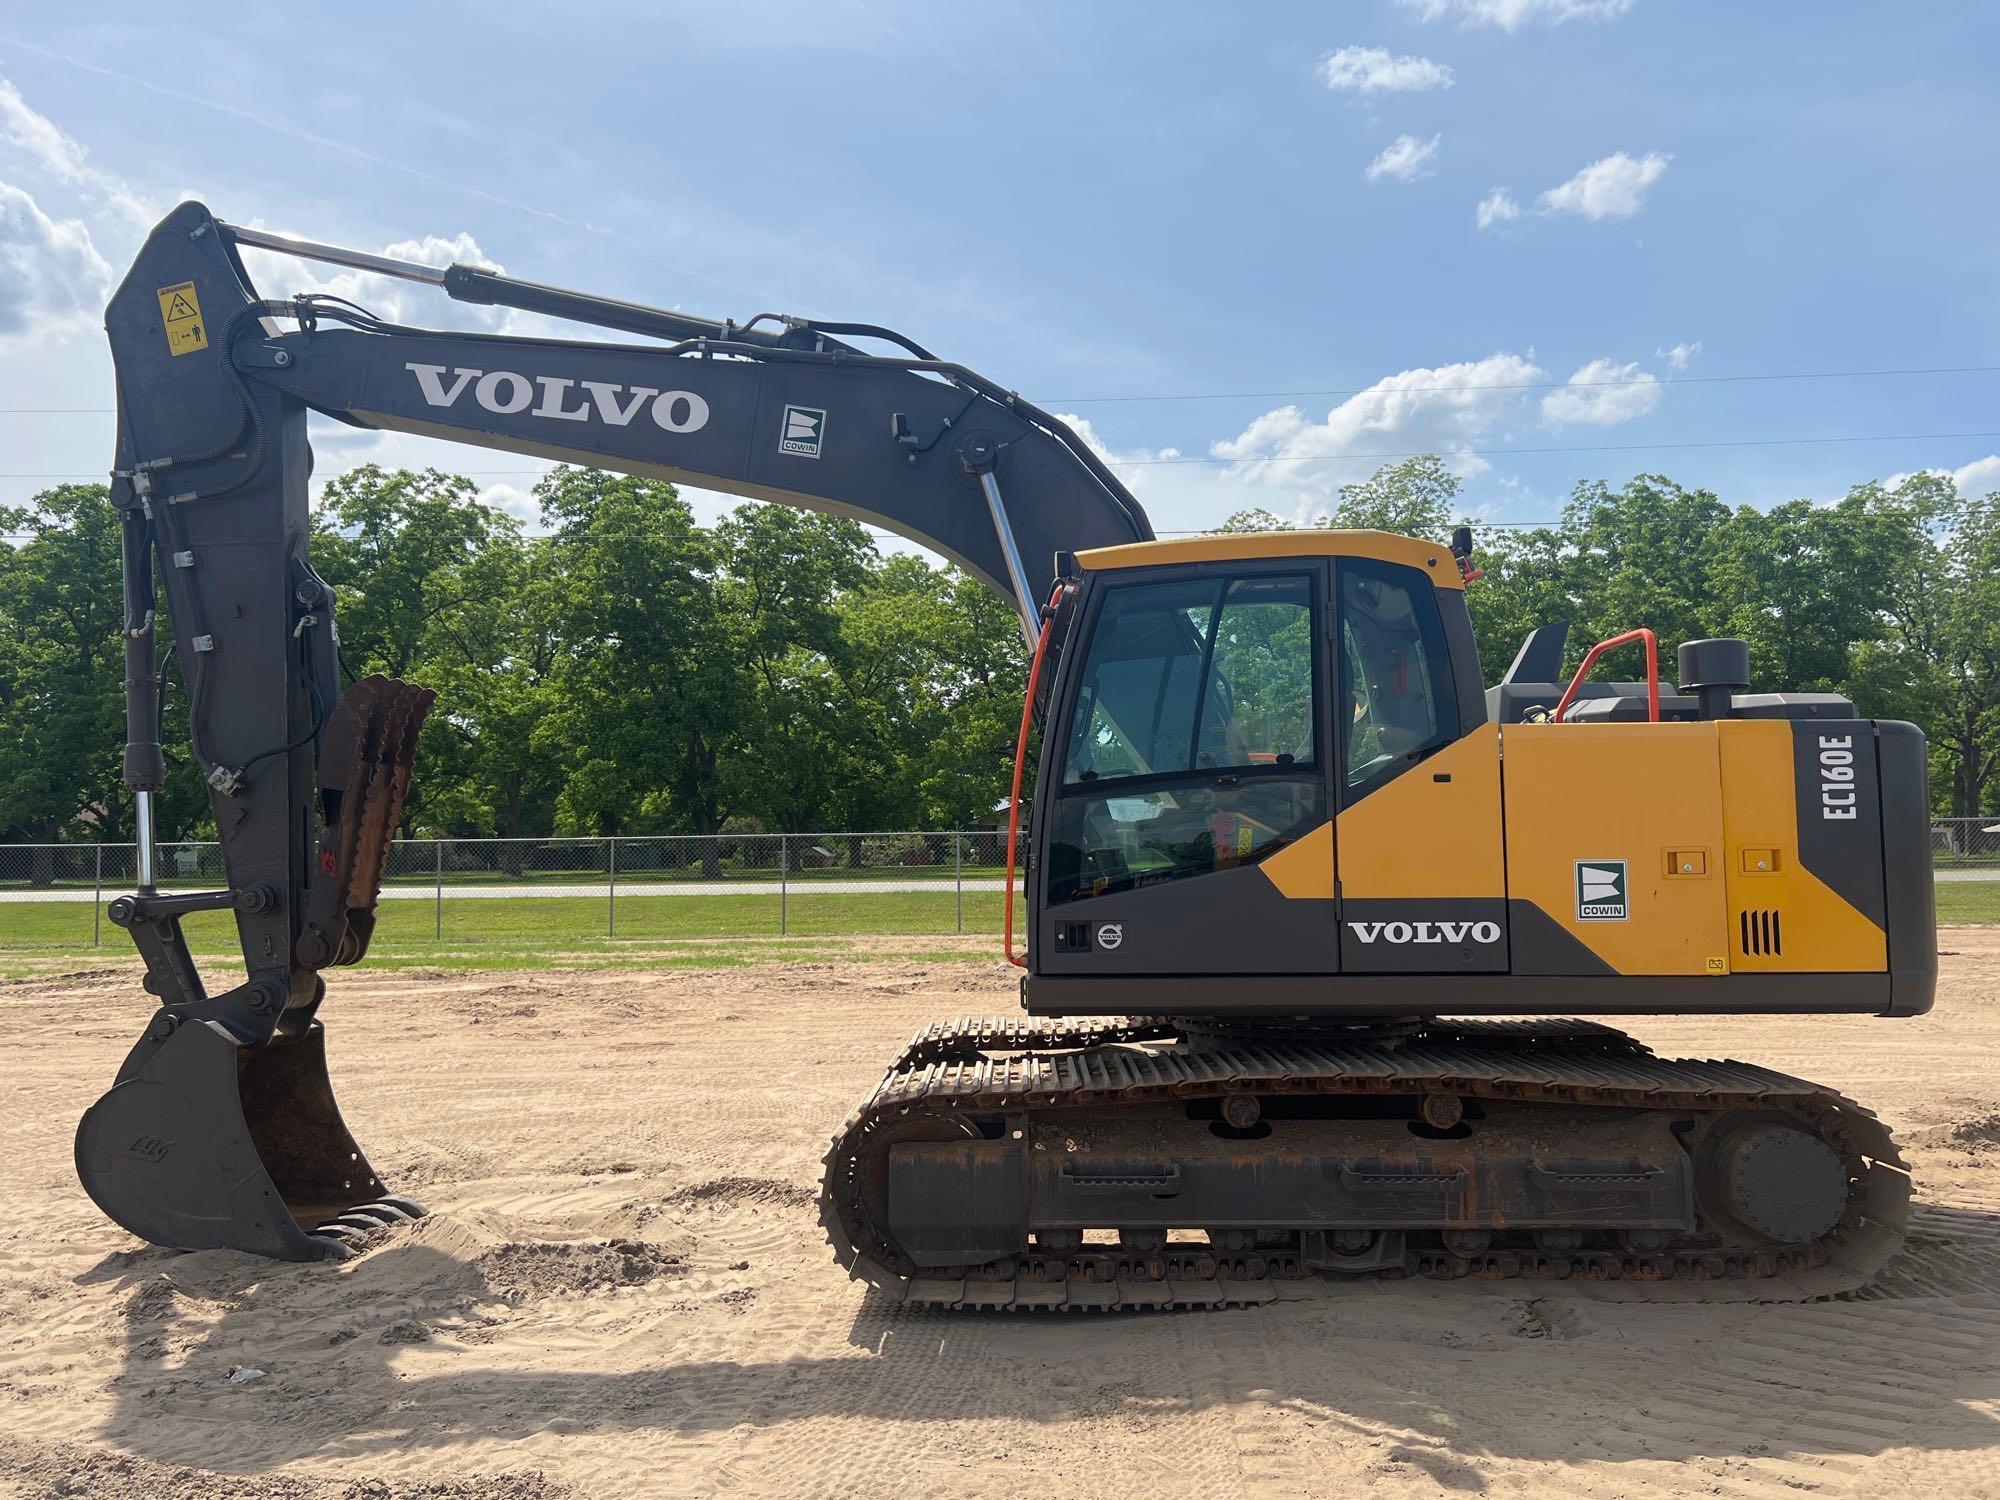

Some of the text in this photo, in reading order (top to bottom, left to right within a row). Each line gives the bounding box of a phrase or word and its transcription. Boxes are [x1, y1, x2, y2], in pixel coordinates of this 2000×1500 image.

[405, 362, 710, 434] VOLVO
[785, 441, 816, 452] COWIN
[1819, 735, 1857, 819] EC160E
[1583, 906, 1622, 915] COWIN
[1347, 921, 1501, 944] VOLVO
